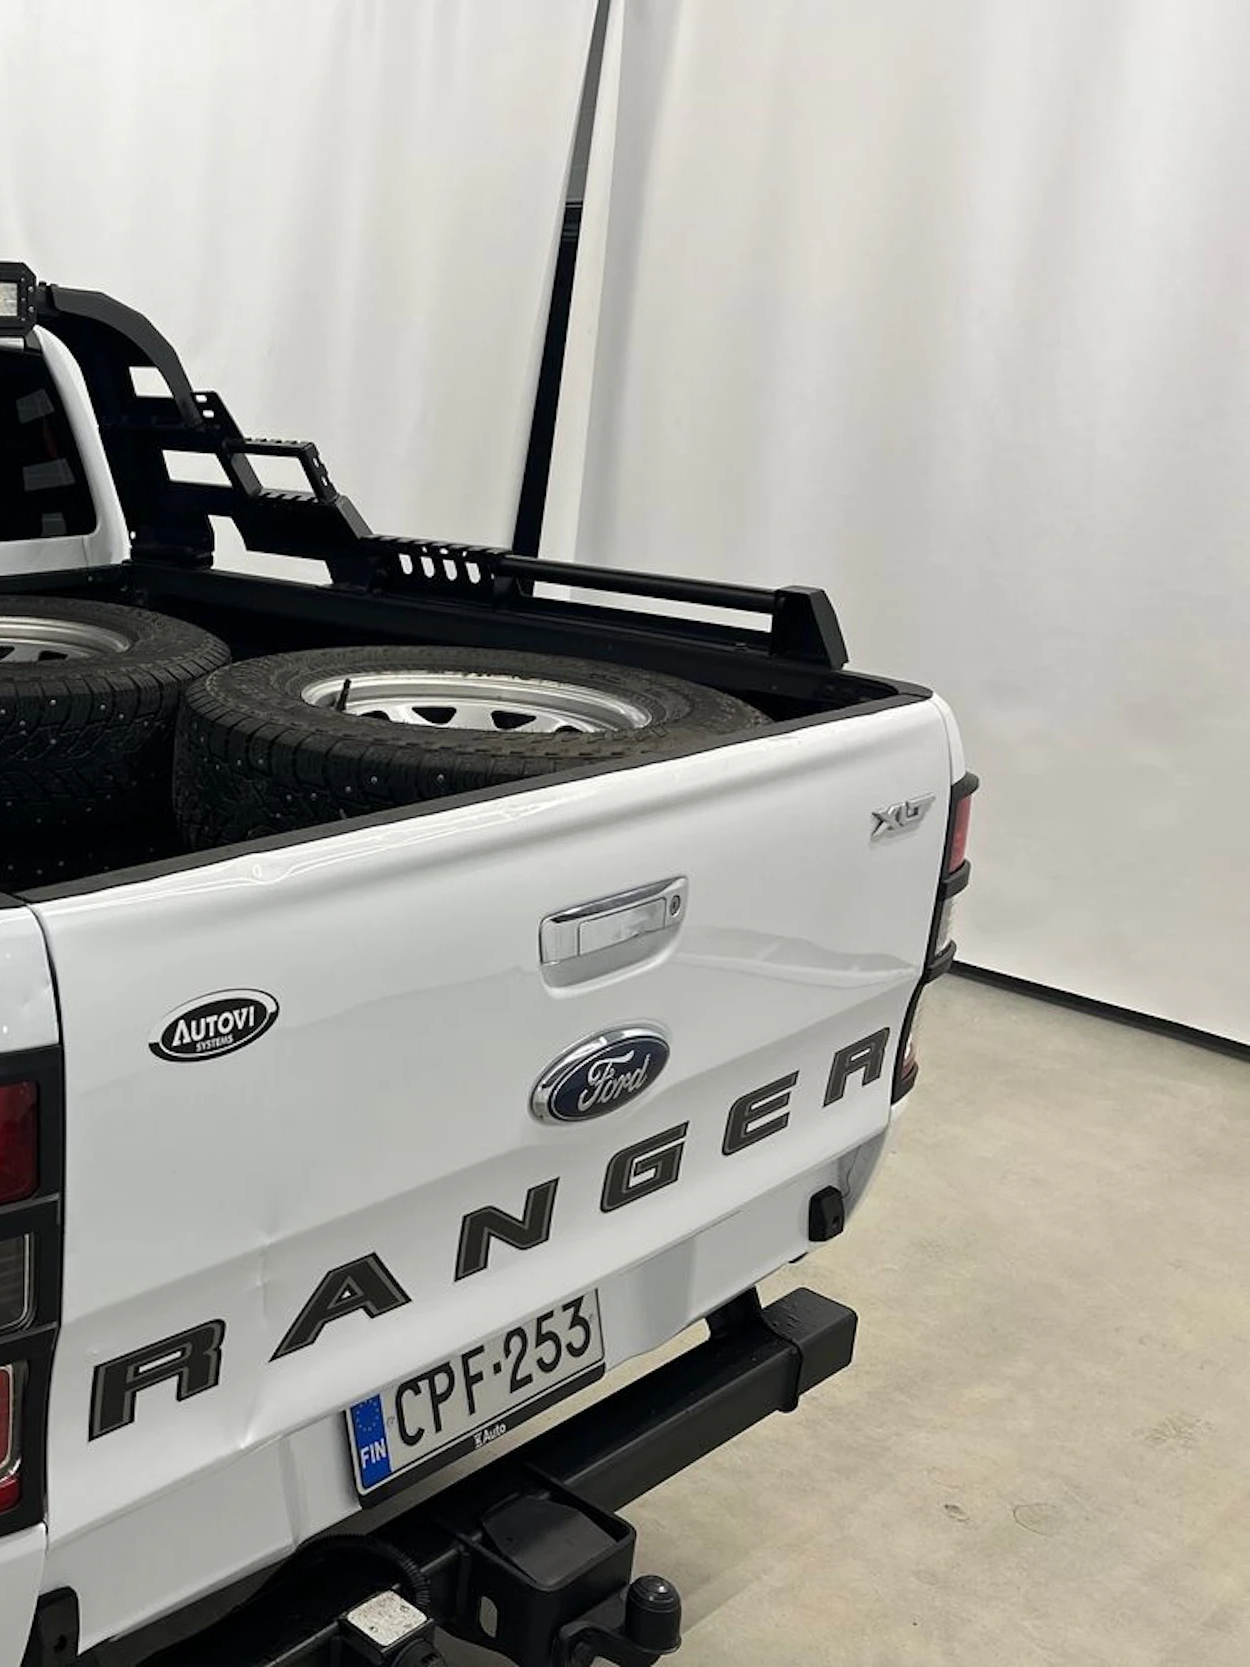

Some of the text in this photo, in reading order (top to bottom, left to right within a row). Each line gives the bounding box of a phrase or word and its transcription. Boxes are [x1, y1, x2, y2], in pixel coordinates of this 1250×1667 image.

[870, 792, 937, 842] XLT
[171, 1005, 255, 1047] AUTOVI
[195, 1033, 234, 1052] SYSTEMS
[577, 1049, 651, 1112] Ford
[88, 1027, 892, 1442] RANGER
[394, 1295, 591, 1446] CPF-253
[360, 1437, 386, 1468] FIN
